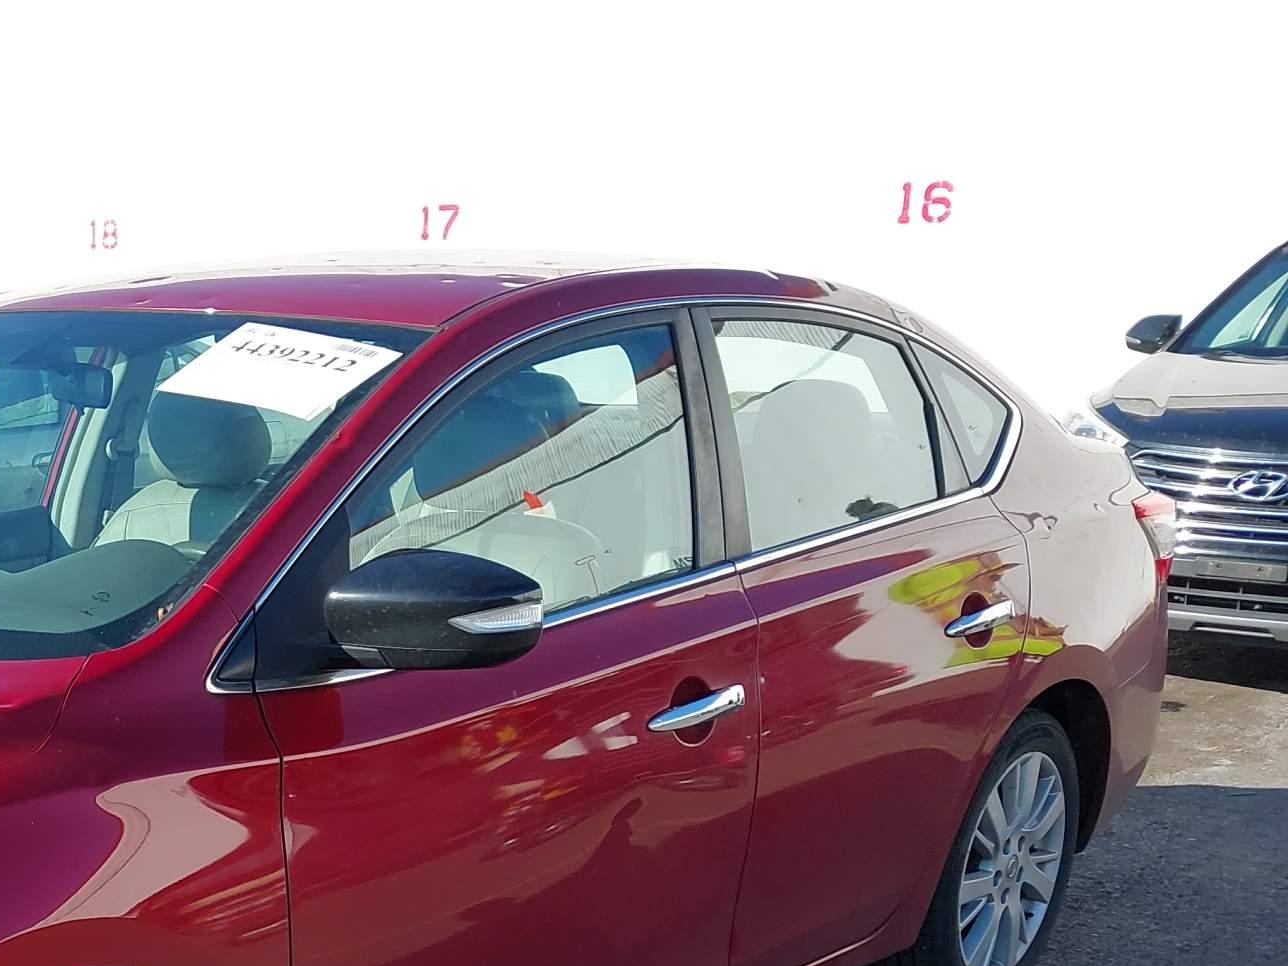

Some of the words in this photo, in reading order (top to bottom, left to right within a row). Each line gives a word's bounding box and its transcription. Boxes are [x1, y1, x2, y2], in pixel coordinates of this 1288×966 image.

[897, 180, 954, 225] 16
[91, 219, 118, 249] 18
[420, 203, 461, 241] 17
[231, 340, 358, 372] 44392212
